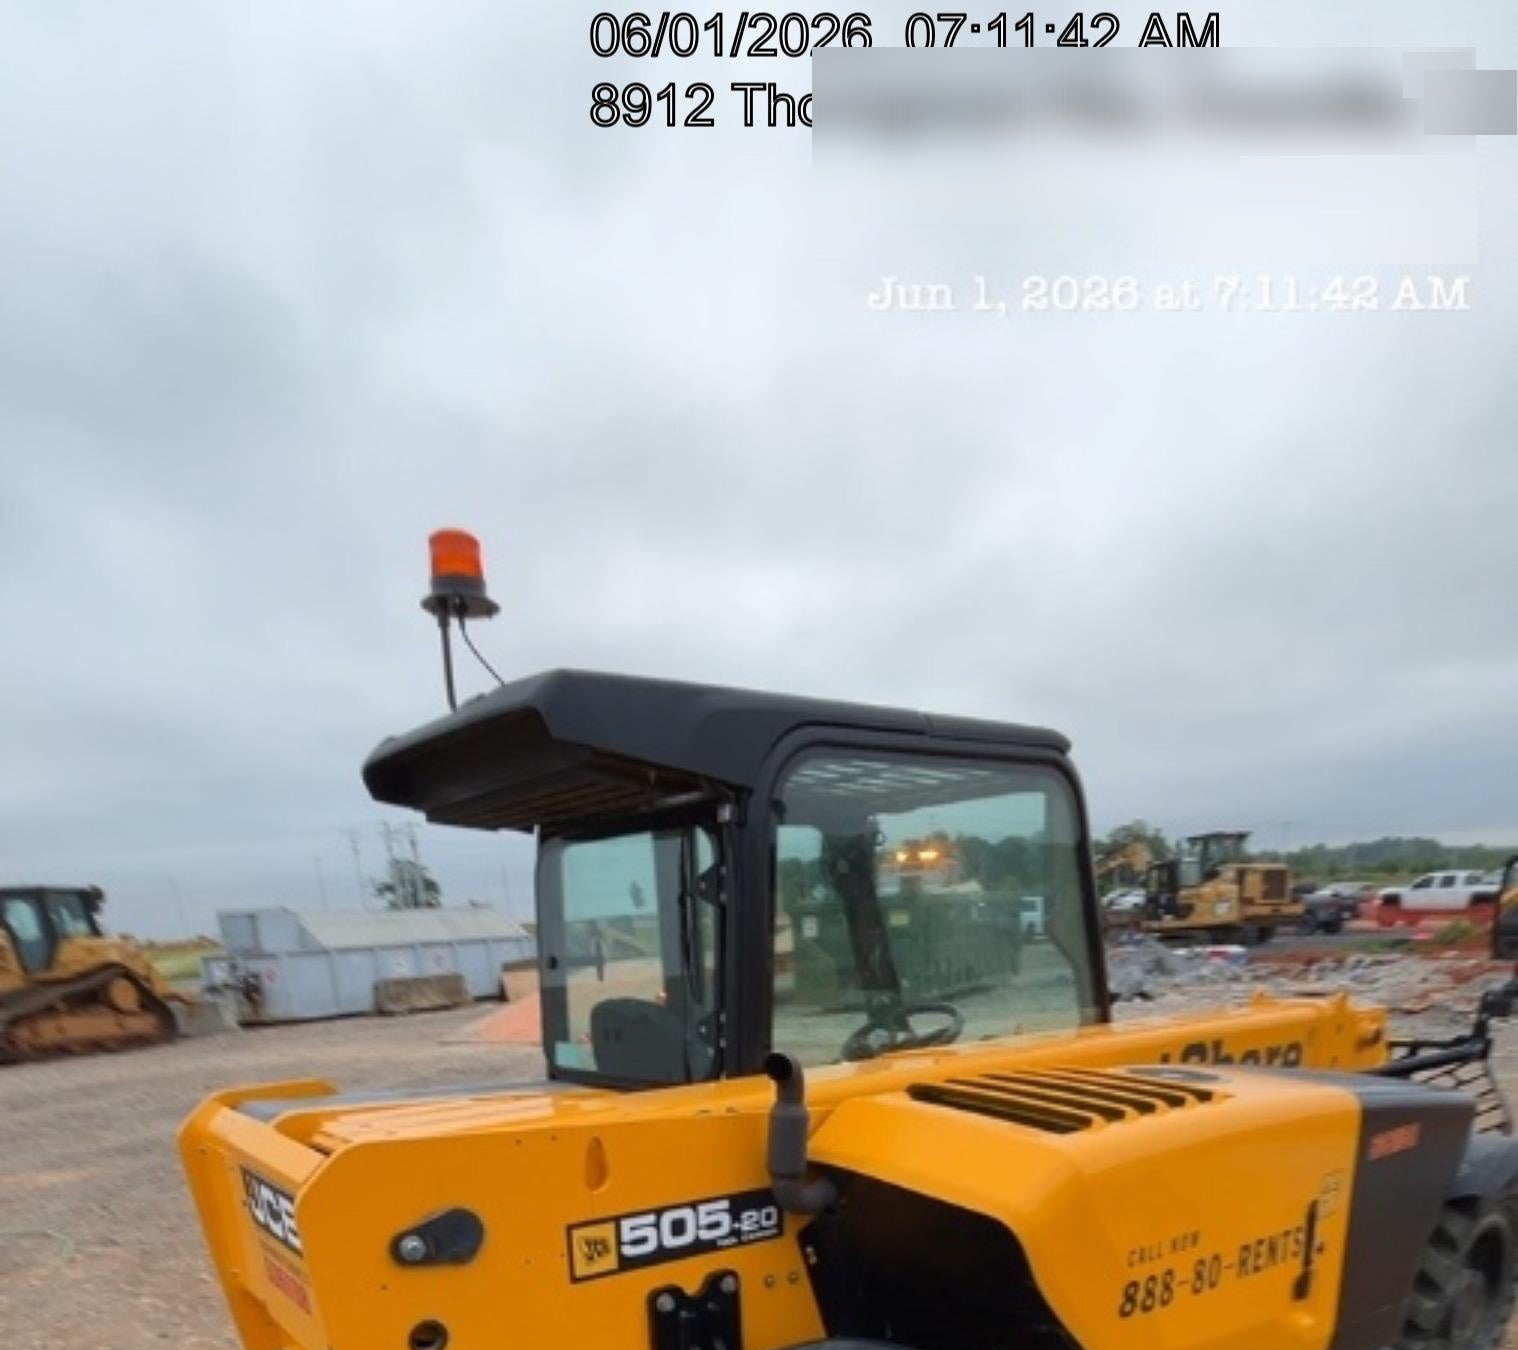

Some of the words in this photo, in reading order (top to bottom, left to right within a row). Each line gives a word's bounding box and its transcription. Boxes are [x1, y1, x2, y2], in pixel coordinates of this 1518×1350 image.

[1118, 1225, 1304, 1319] 888-80-RENTS
[1127, 1241, 1163, 1269] CALL
[1169, 1230, 1200, 1254] NOW
